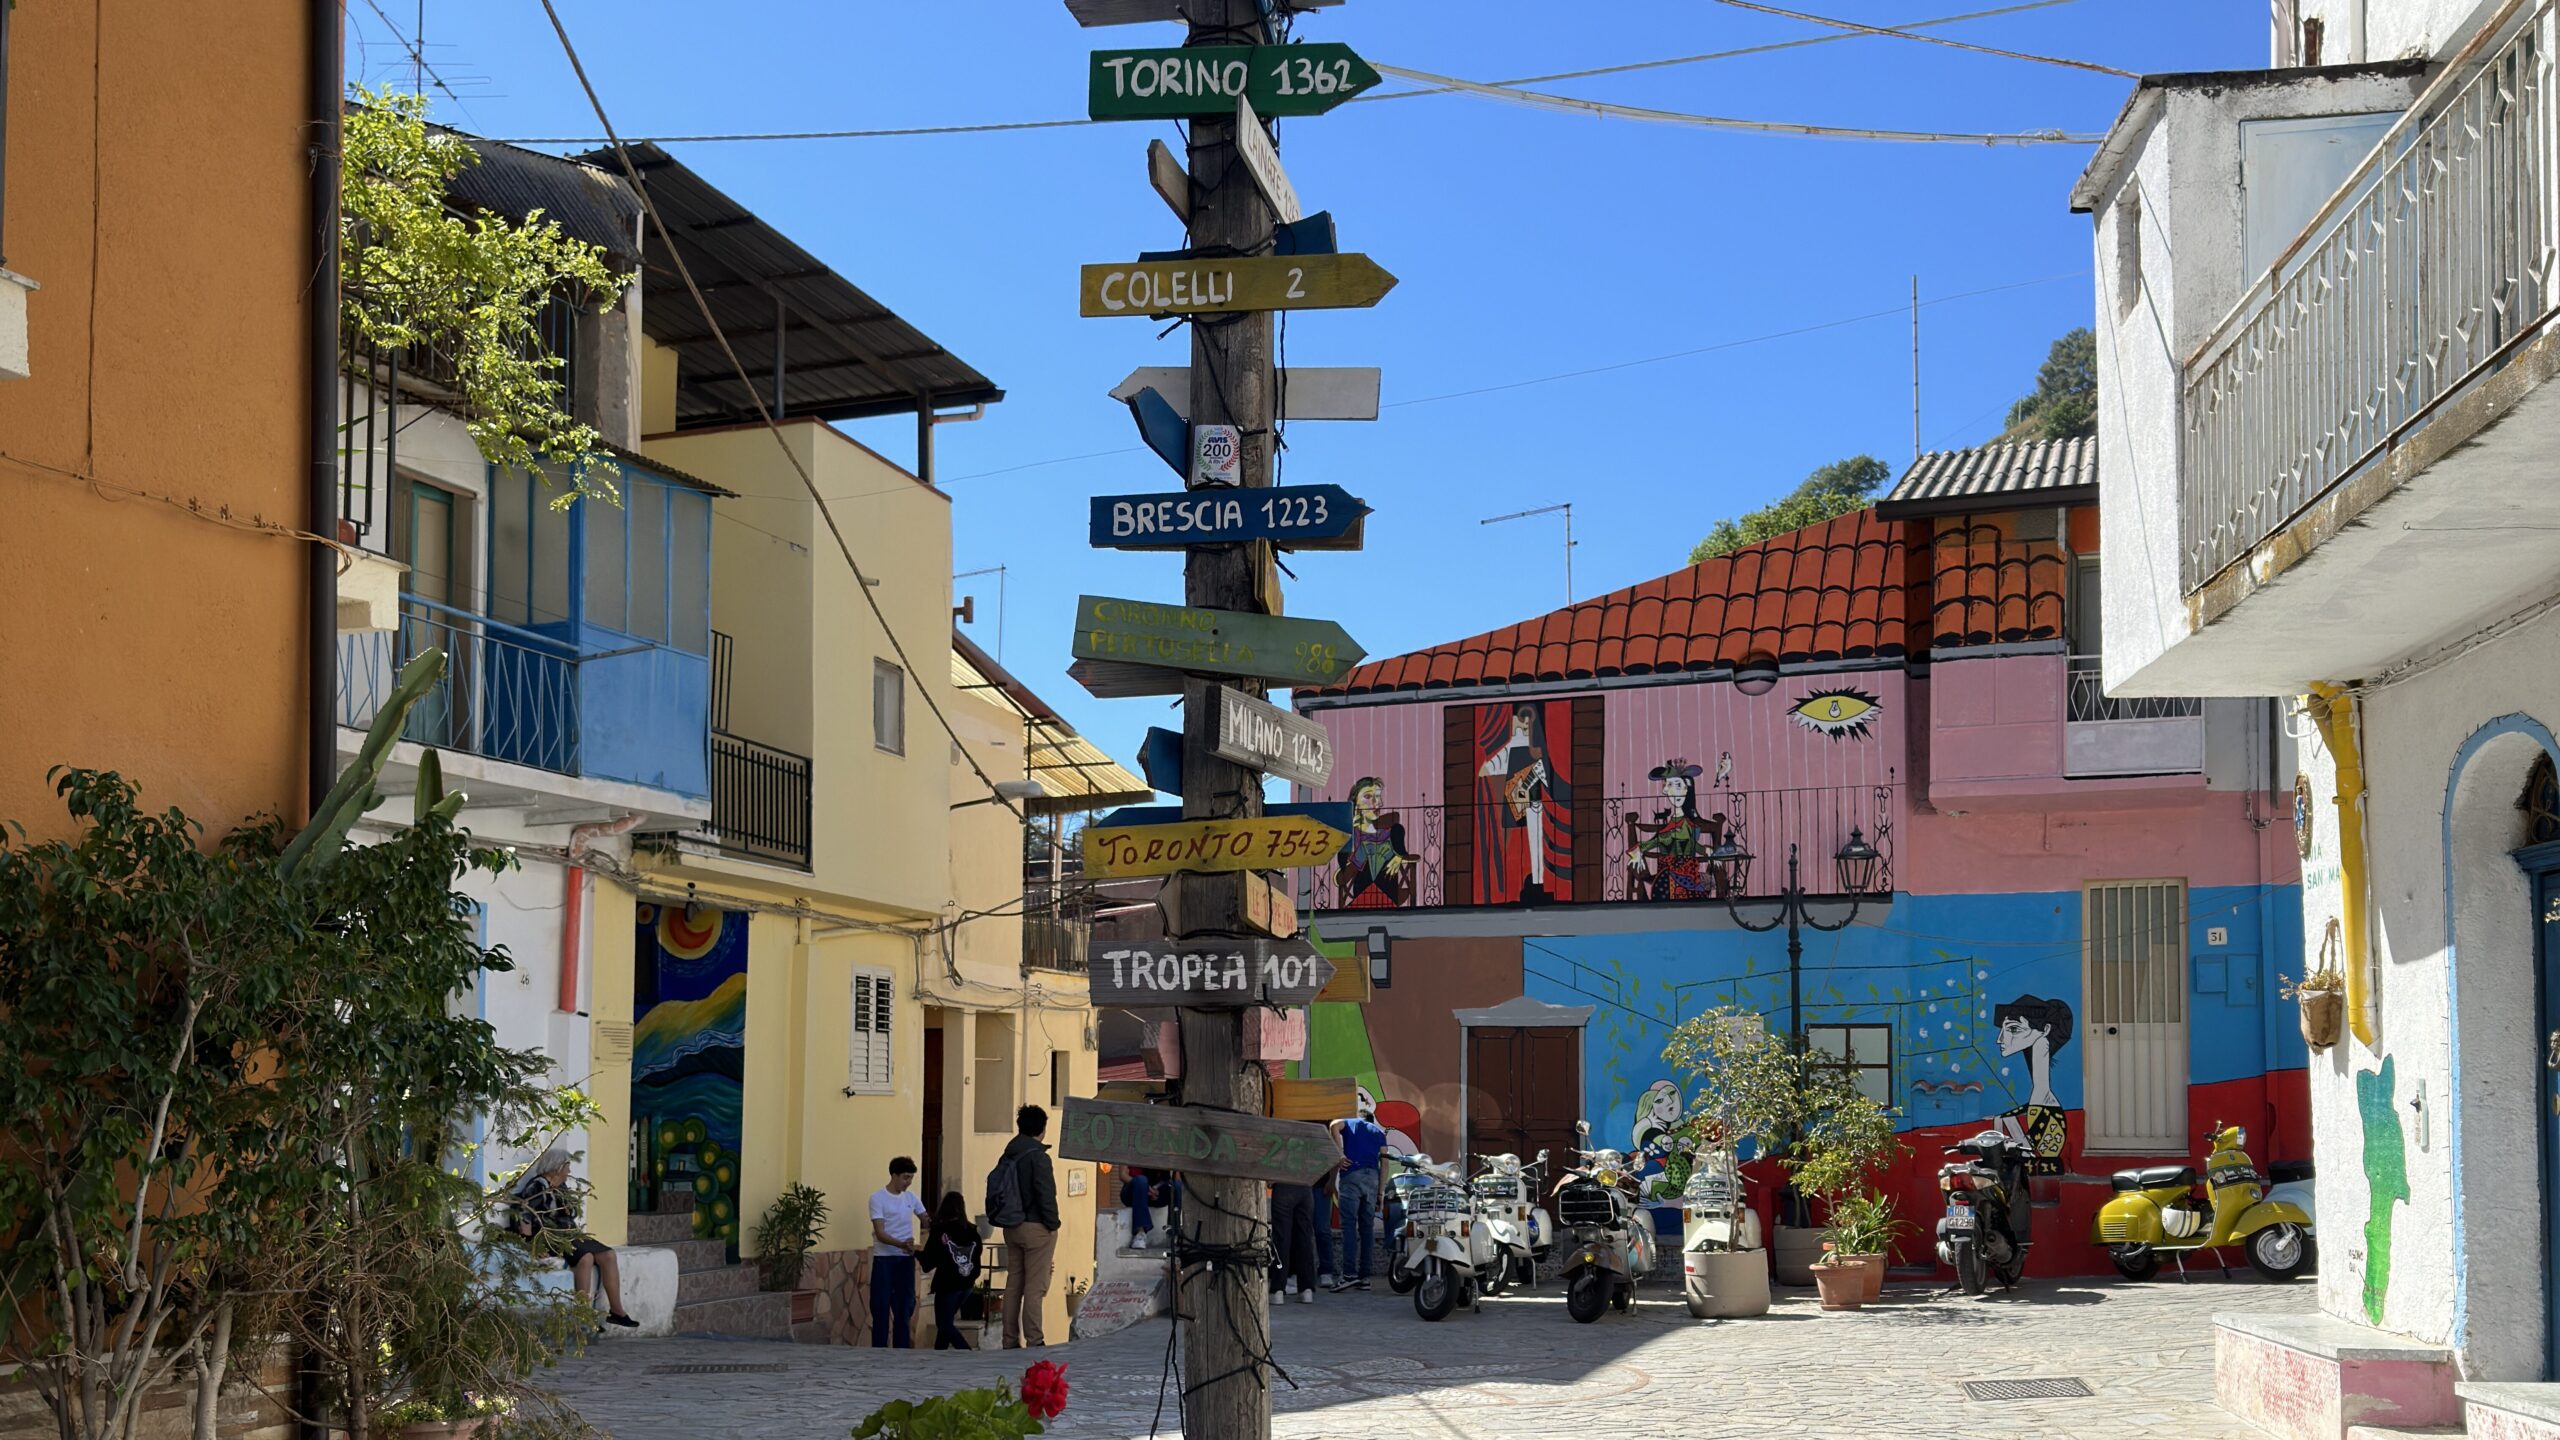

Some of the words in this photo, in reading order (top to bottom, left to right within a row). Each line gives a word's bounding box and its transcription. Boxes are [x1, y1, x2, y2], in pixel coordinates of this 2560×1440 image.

[1102, 55, 1249, 99] TORINO
[1269, 57, 1357, 97] 1362
[1247, 117, 1282, 202] LAINATE
[1100, 269, 1233, 312] COLELLI
[1285, 266, 1306, 300] 2
[1202, 443, 1232, 457] 200
[1112, 500, 1244, 538] BRESCIA
[1260, 494, 1330, 530] 1223
[1228, 702, 1284, 758] MILANO
[1291, 731, 1325, 774] 1243
[1265, 828, 1331, 859] 7543
[2307, 868, 2323, 889] SAN
[1101, 949, 1248, 991] TROPEA
[1263, 954, 1319, 990] 101
[1066, 1112, 1238, 1163] ROTONDA
